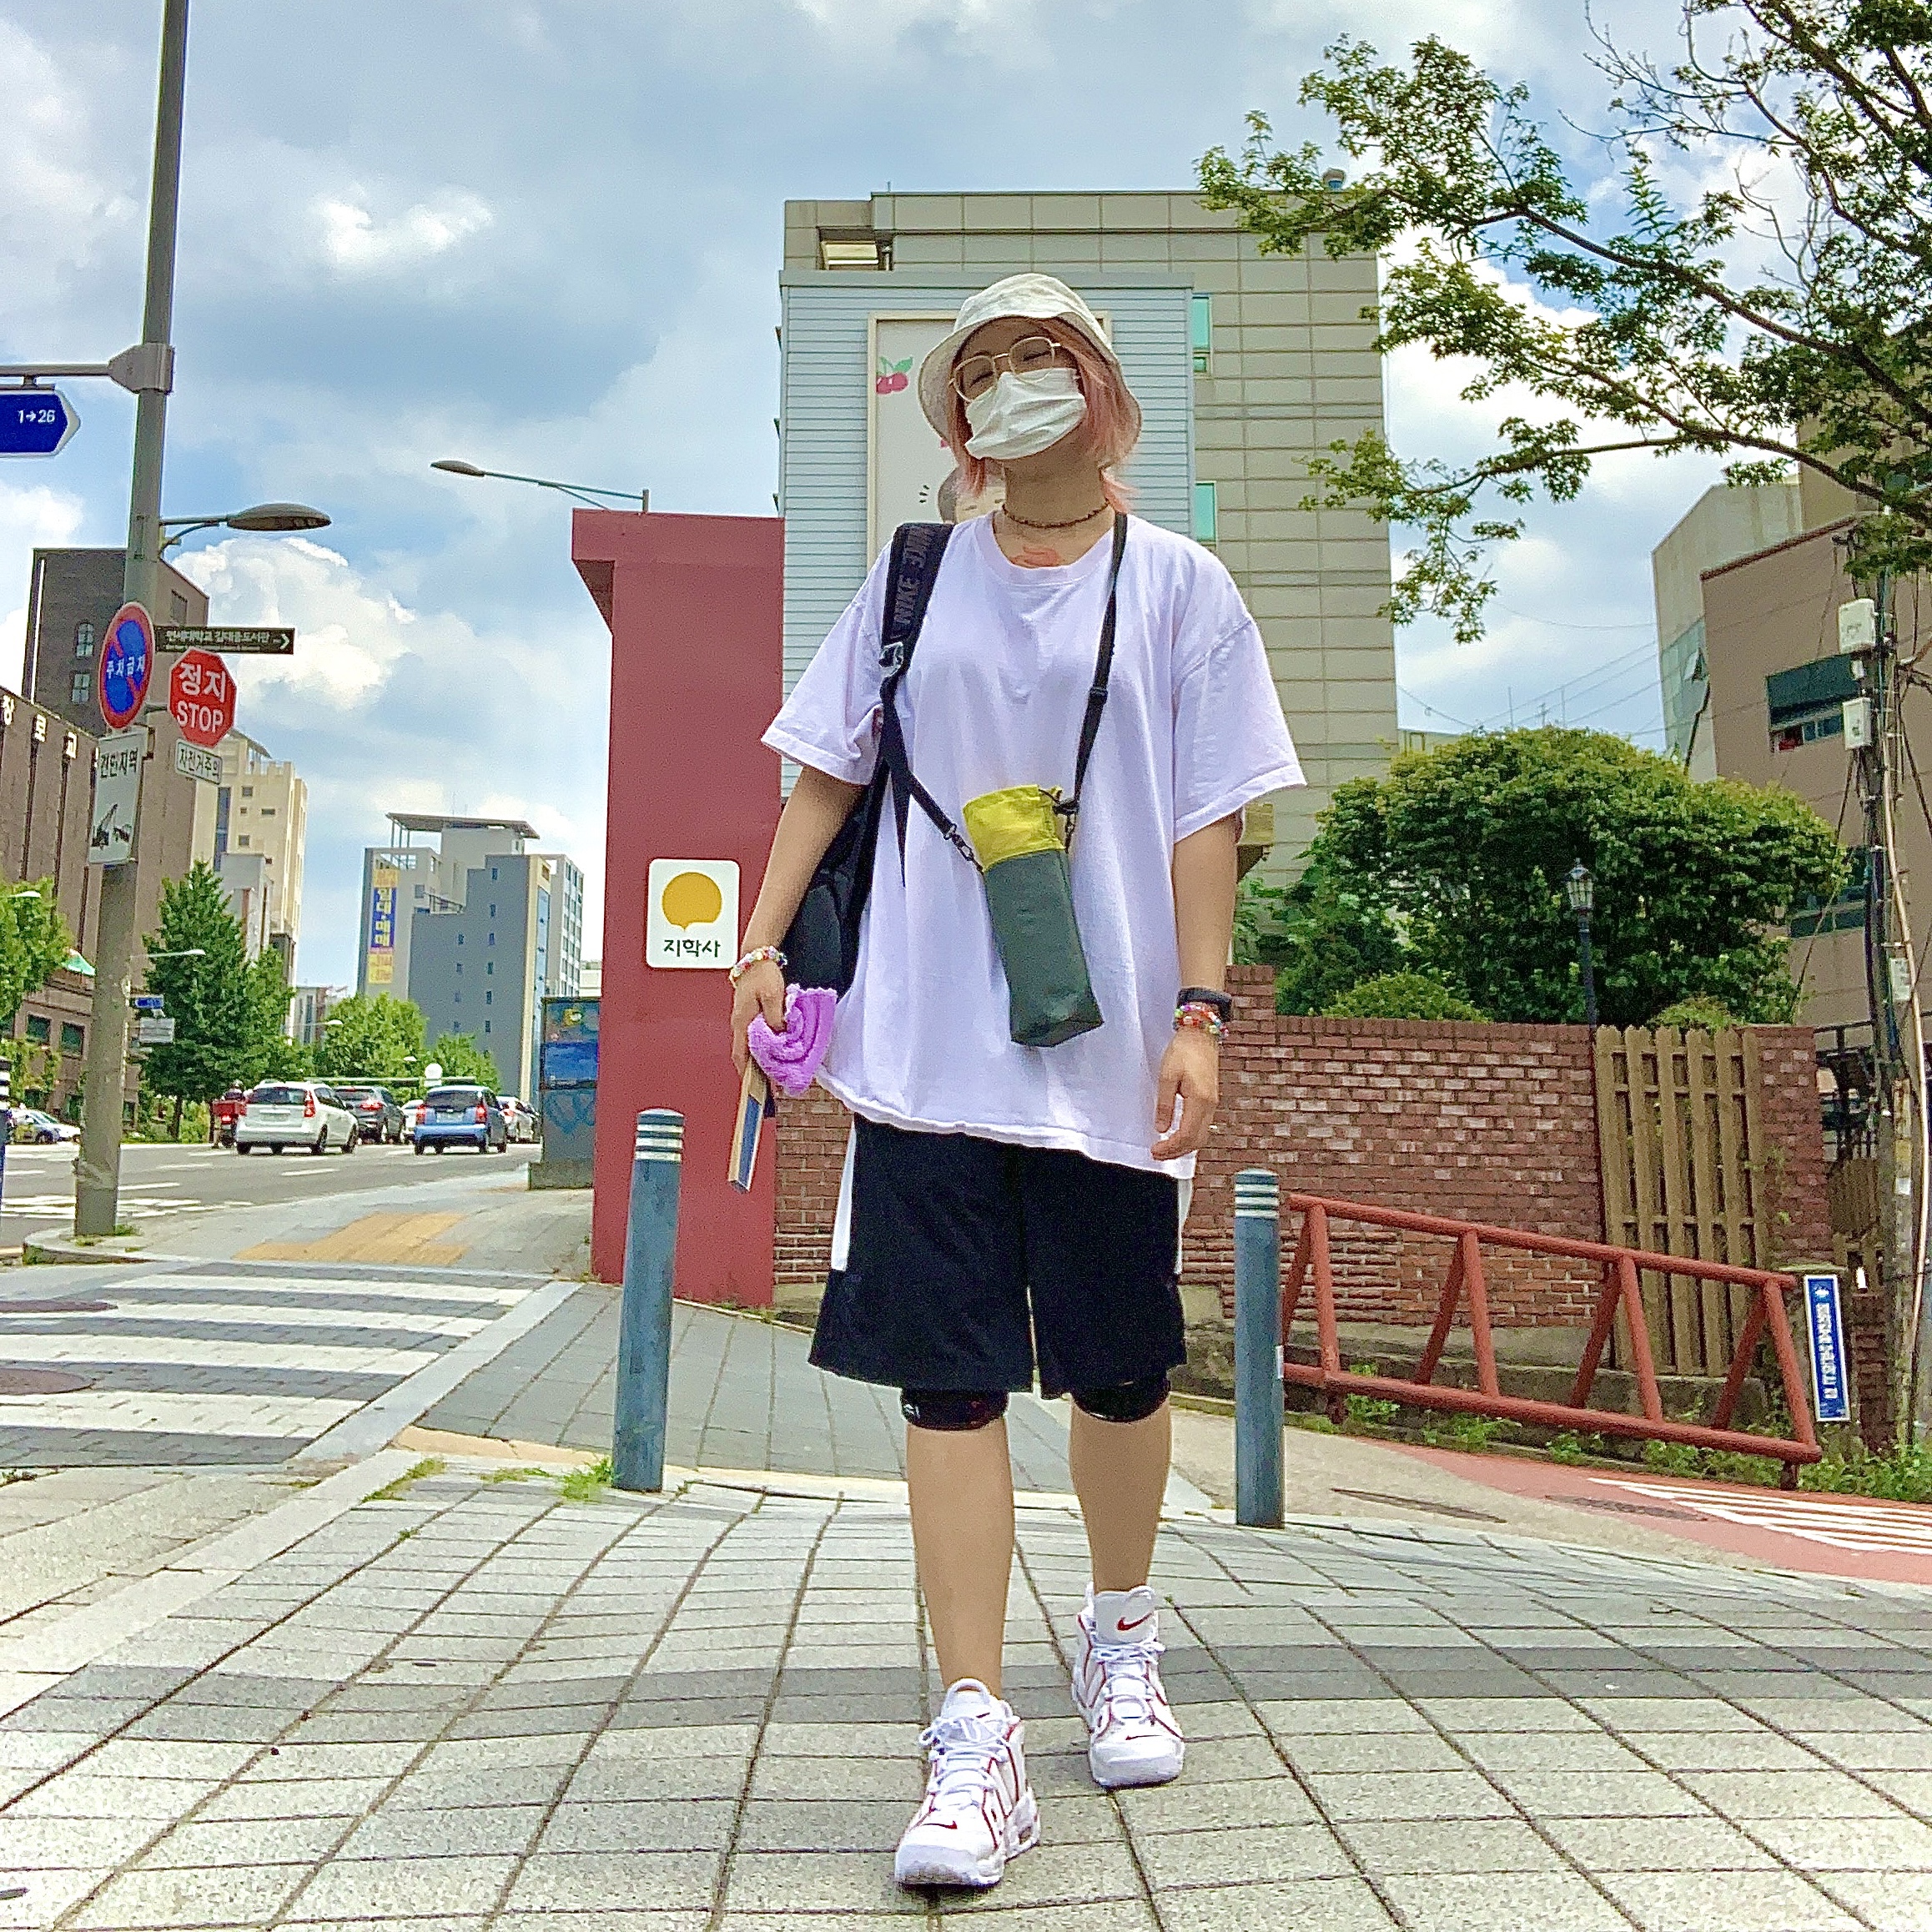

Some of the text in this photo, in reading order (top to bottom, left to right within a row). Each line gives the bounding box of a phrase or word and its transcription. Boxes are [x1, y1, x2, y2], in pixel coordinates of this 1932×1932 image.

[893, 574, 918, 625] NIKE
[106, 654, 146, 679] 주차금지
[179, 662, 226, 703] 정지
[176, 700, 224, 733] STOP
[179, 748, 220, 780] 자전거주의
[663, 939, 722, 958] 지학사
